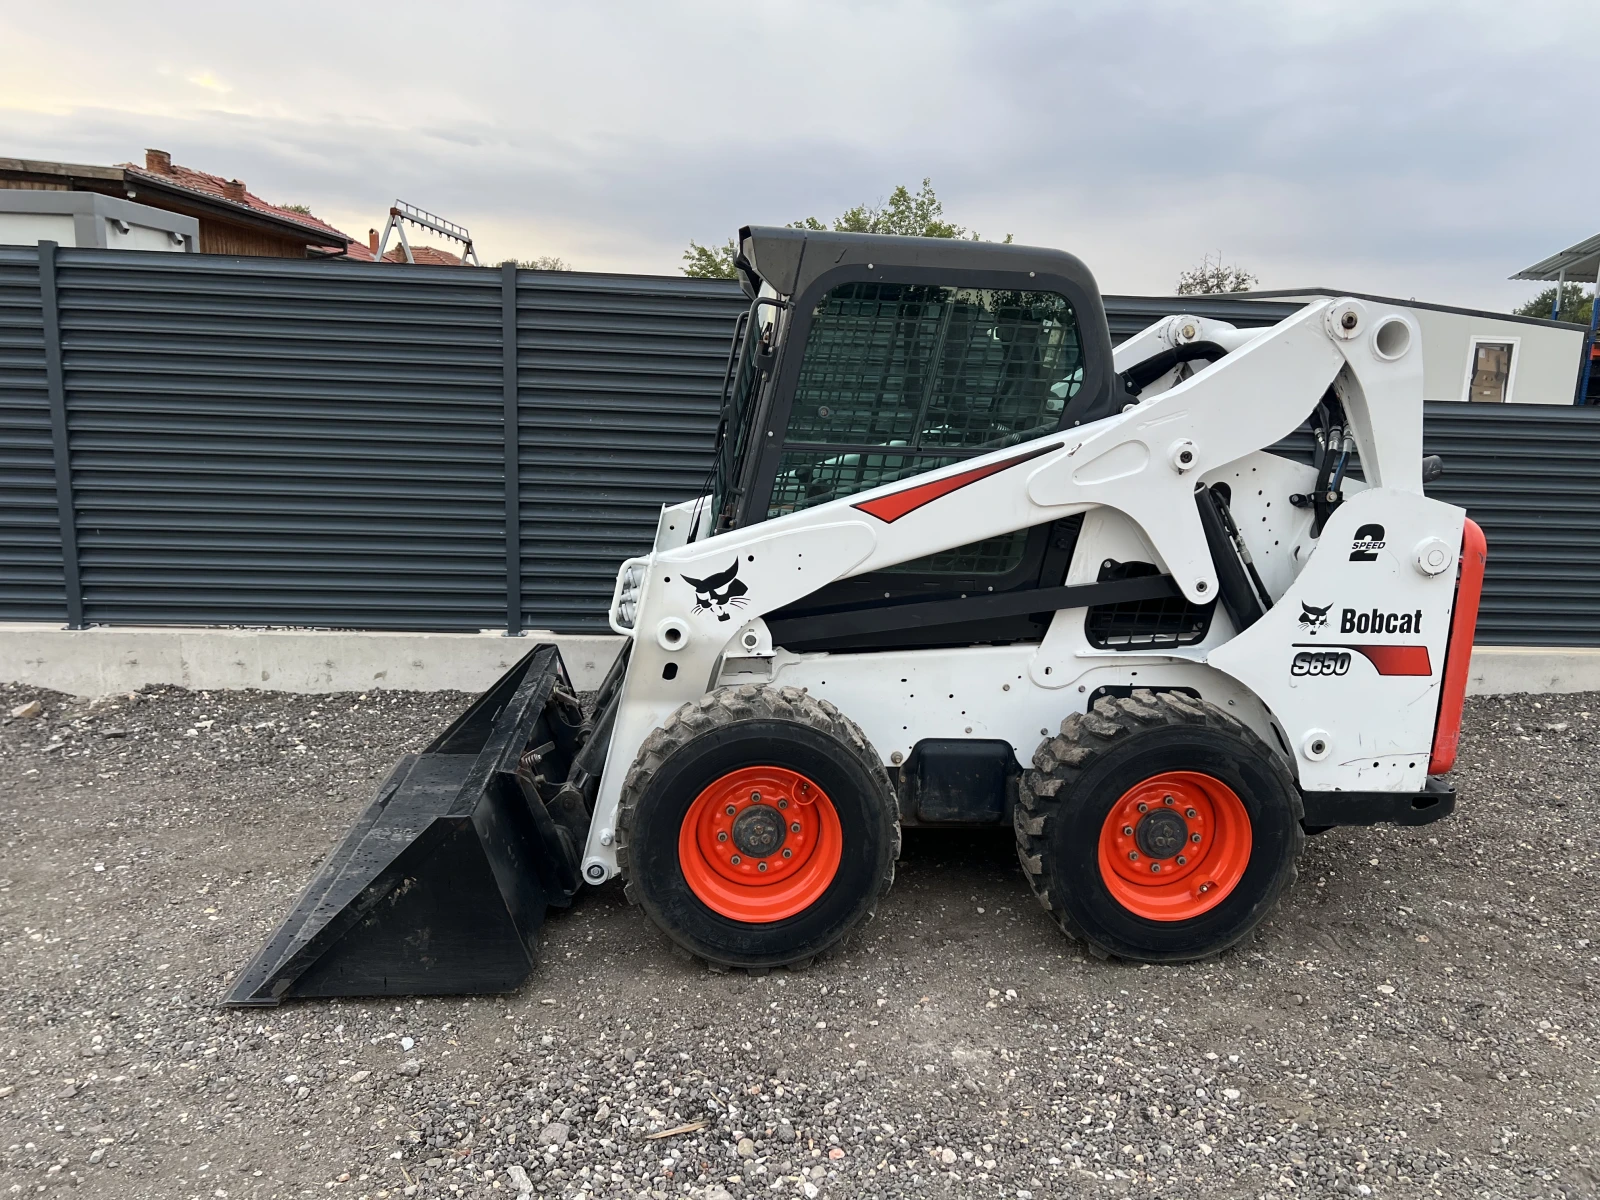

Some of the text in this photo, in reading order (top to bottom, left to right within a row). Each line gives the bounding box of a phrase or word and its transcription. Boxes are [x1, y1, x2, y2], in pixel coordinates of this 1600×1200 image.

[1348, 523, 1385, 562] 2
[1351, 541, 1386, 550] SPEED
[1340, 608, 1422, 634] Bobcat
[1291, 652, 1351, 676] S650
